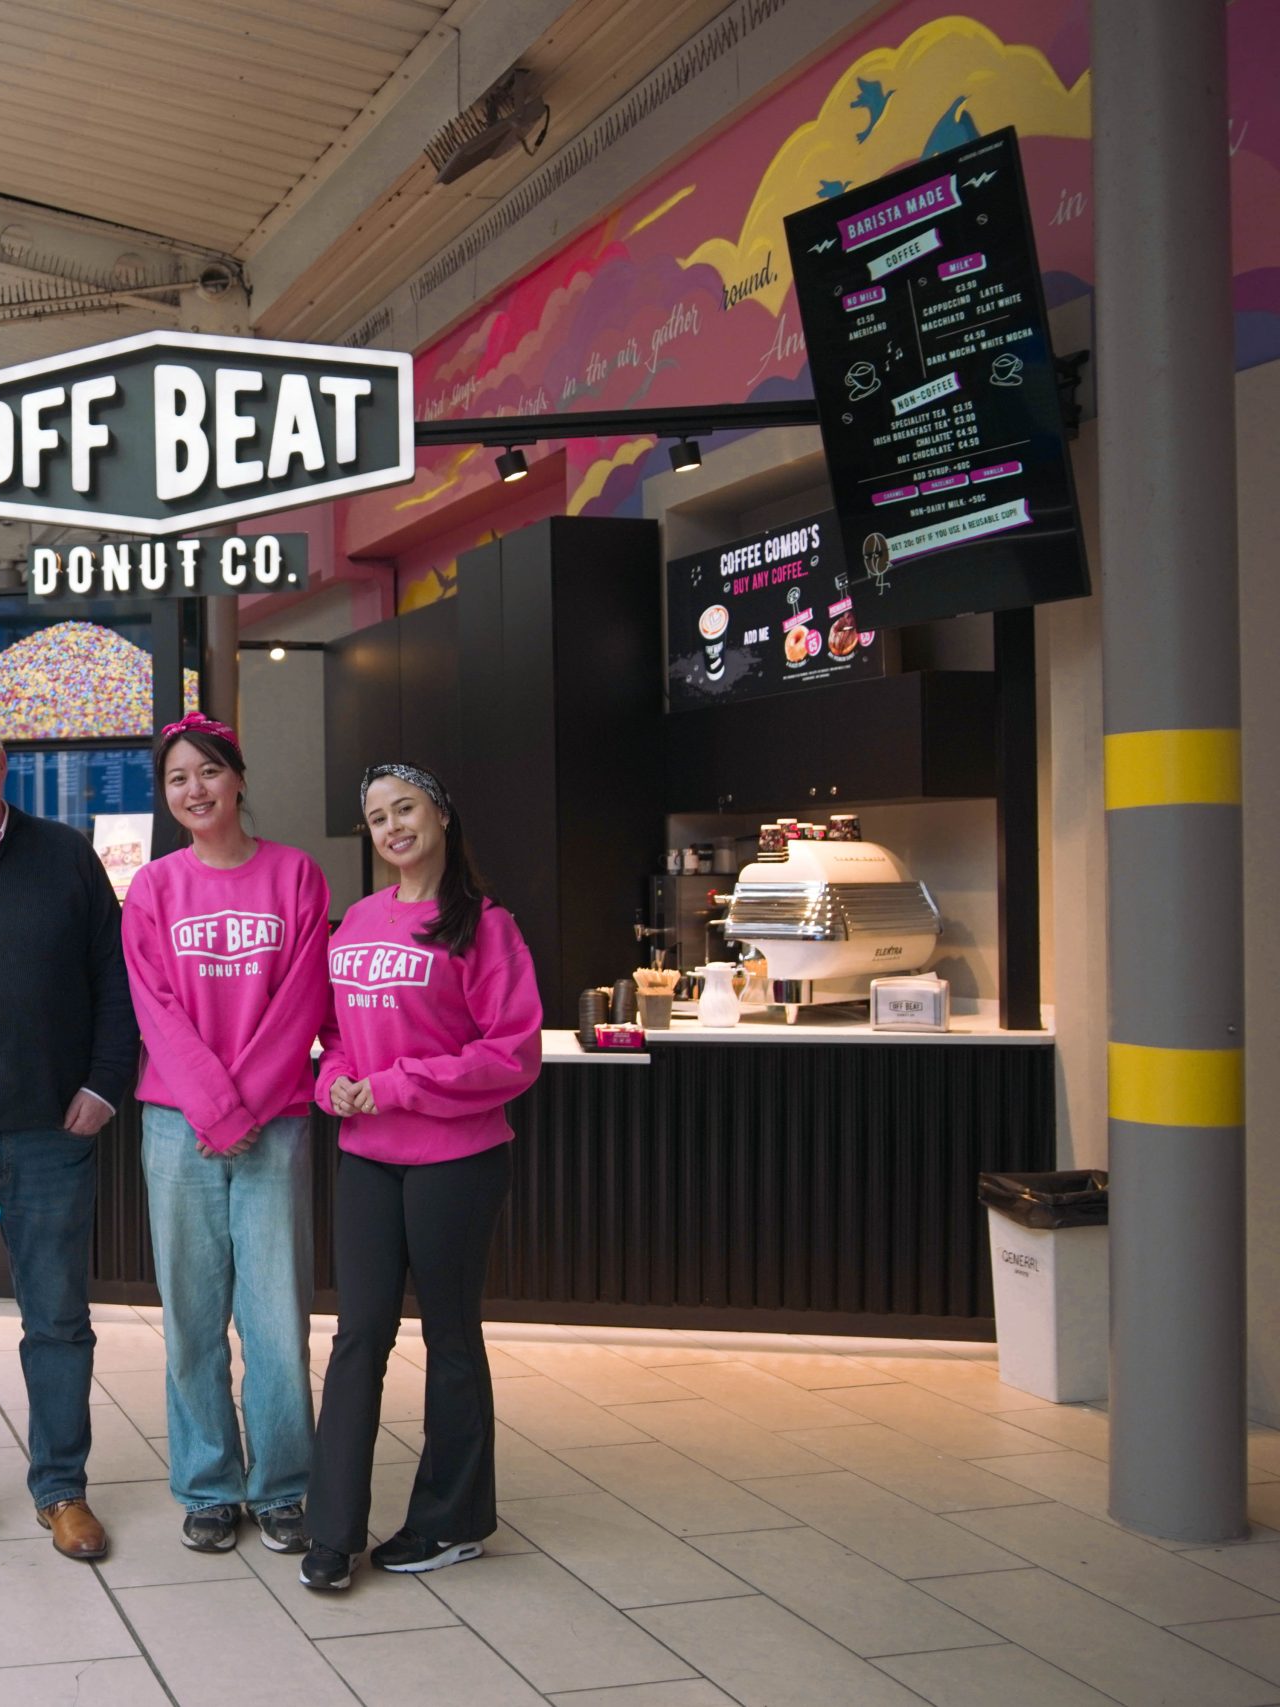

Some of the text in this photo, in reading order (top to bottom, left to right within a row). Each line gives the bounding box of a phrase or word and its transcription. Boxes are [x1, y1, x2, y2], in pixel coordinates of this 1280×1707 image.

[847, 186, 945, 239] BARISTA MADE
[885, 242, 921, 268] COFFEE
[847, 290, 878, 306] NO MILK
[980, 283, 1004, 298] LATTE
[922, 294, 971, 317] CAPPUCCINO
[976, 293, 1022, 315] FLAT WHITE
[585, 351, 607, 383] the
[645, 303, 702, 374] gather
[719, 250, 778, 311] round.
[921, 311, 965, 332] MACCHIATO
[849, 322, 887, 341] AMERICANO
[980, 327, 1033, 350] WHITE MOCHA
[926, 344, 976, 366] DARK MOCHA
[897, 378, 954, 410] NON-COFFEE
[890, 413, 930, 430] SPECIALITY
[932, 408, 946, 419] TEA
[154, 364, 372, 501] BEAT
[873, 435, 891, 446] IRISH
[892, 424, 932, 441] BREAKFAST
[915, 437, 931, 447] CHAI
[956, 425, 978, 438] €4.50
[897, 454, 910, 464] HOT
[958, 437, 980, 449] €4.50
[913, 471, 926, 481] ADD
[910, 501, 946, 517] NON-DAIRY
[915, 536, 927, 545] OFF
[935, 530, 948, 539] YOU
[949, 526, 961, 535] USE
[968, 514, 1000, 529] REUSABLE
[720, 523, 820, 577] COFFEE COMBO'S
[33, 536, 297, 595] DONUT CO.
[733, 576, 750, 596] BUY
[752, 572, 769, 591] ANY
[743, 626, 770, 646] ADD ME
[179, 918, 280, 953] OFF BEAT
[875, 945, 903, 957] ELEKTRA
[199, 962, 262, 977] DONUT CO.
[332, 948, 422, 982] OFF BEAT
[382, 994, 399, 1010] CO.
